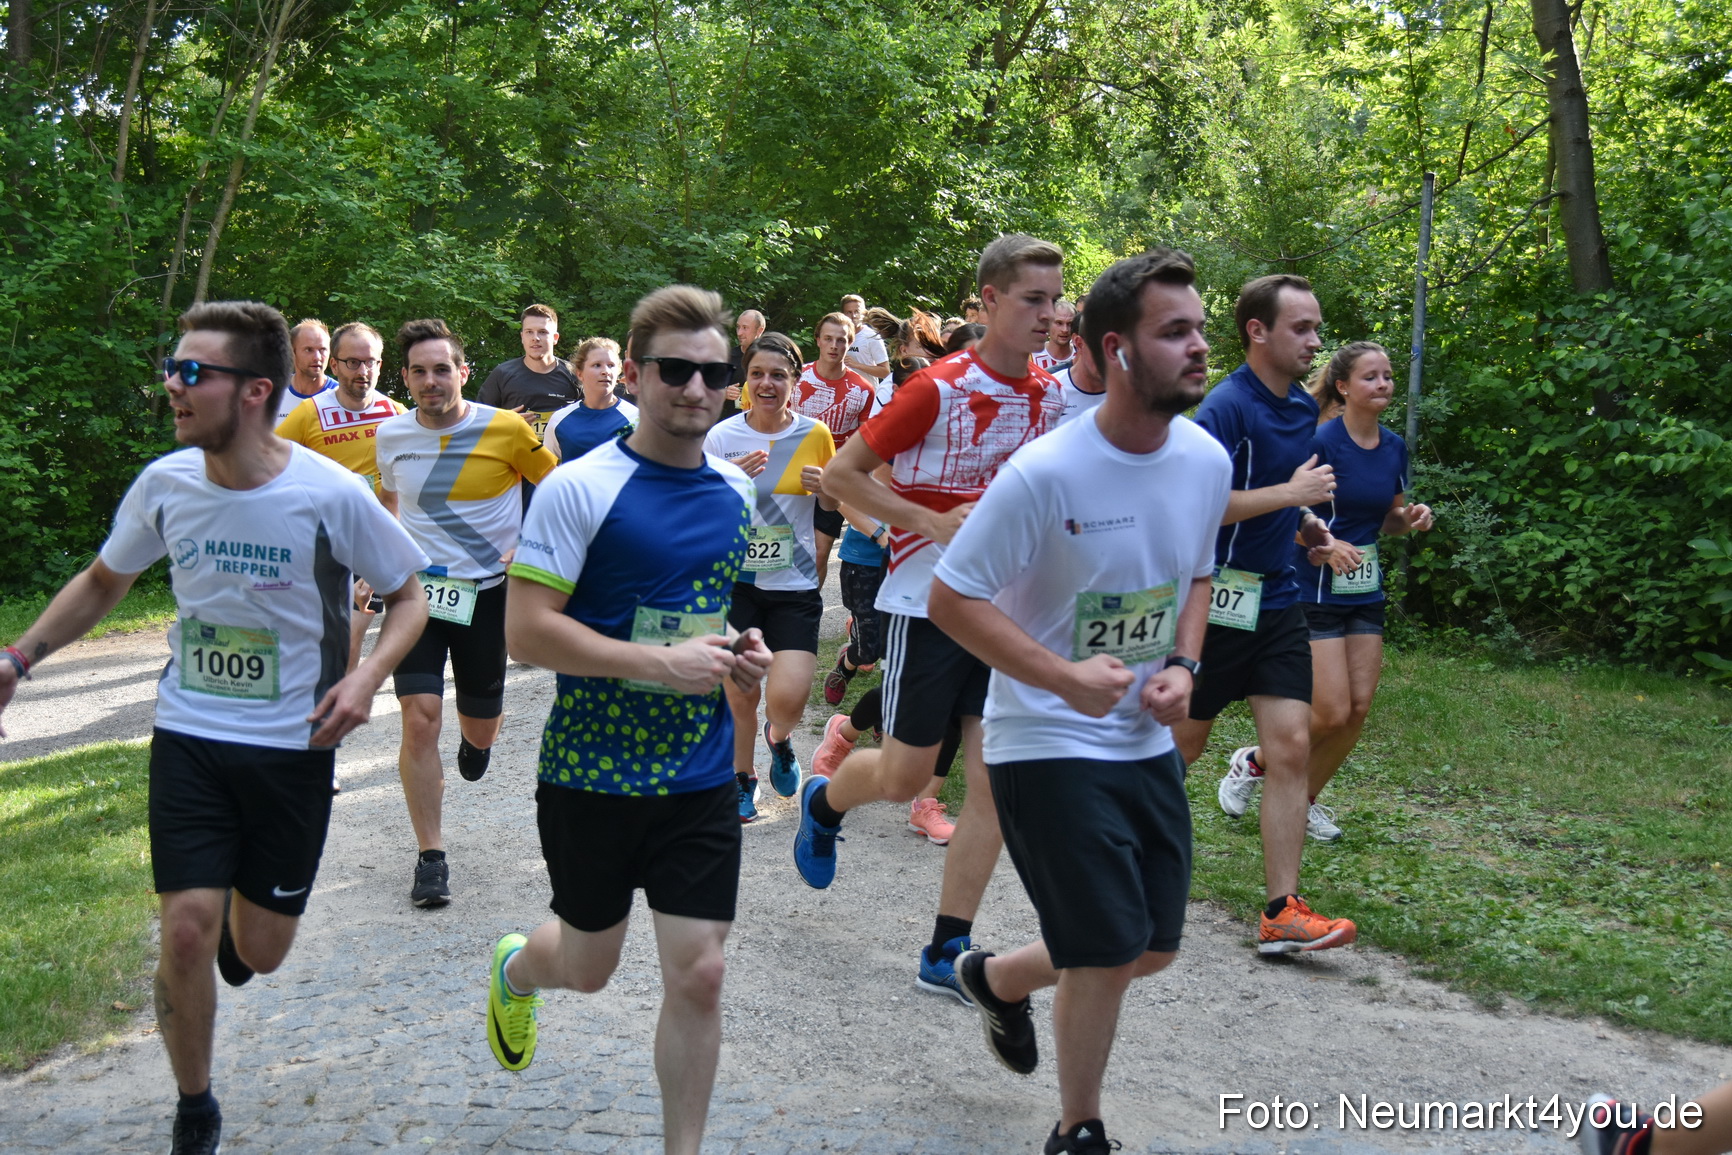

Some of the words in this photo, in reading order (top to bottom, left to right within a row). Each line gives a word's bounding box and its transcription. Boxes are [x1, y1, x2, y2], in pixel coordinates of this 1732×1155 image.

[323, 430, 361, 446] MAX
[364, 425, 377, 439] B
[1082, 516, 1136, 529] SCHWARZ
[204, 539, 293, 564] HAUBNER
[747, 542, 781, 559] 622
[215, 559, 280, 579] TREPPEN
[423, 583, 461, 608] 619
[1086, 610, 1166, 648] 2147
[192, 647, 265, 681] 1009
[202, 674, 229, 687] Ulbrich
[229, 678, 253, 689] Kevin
